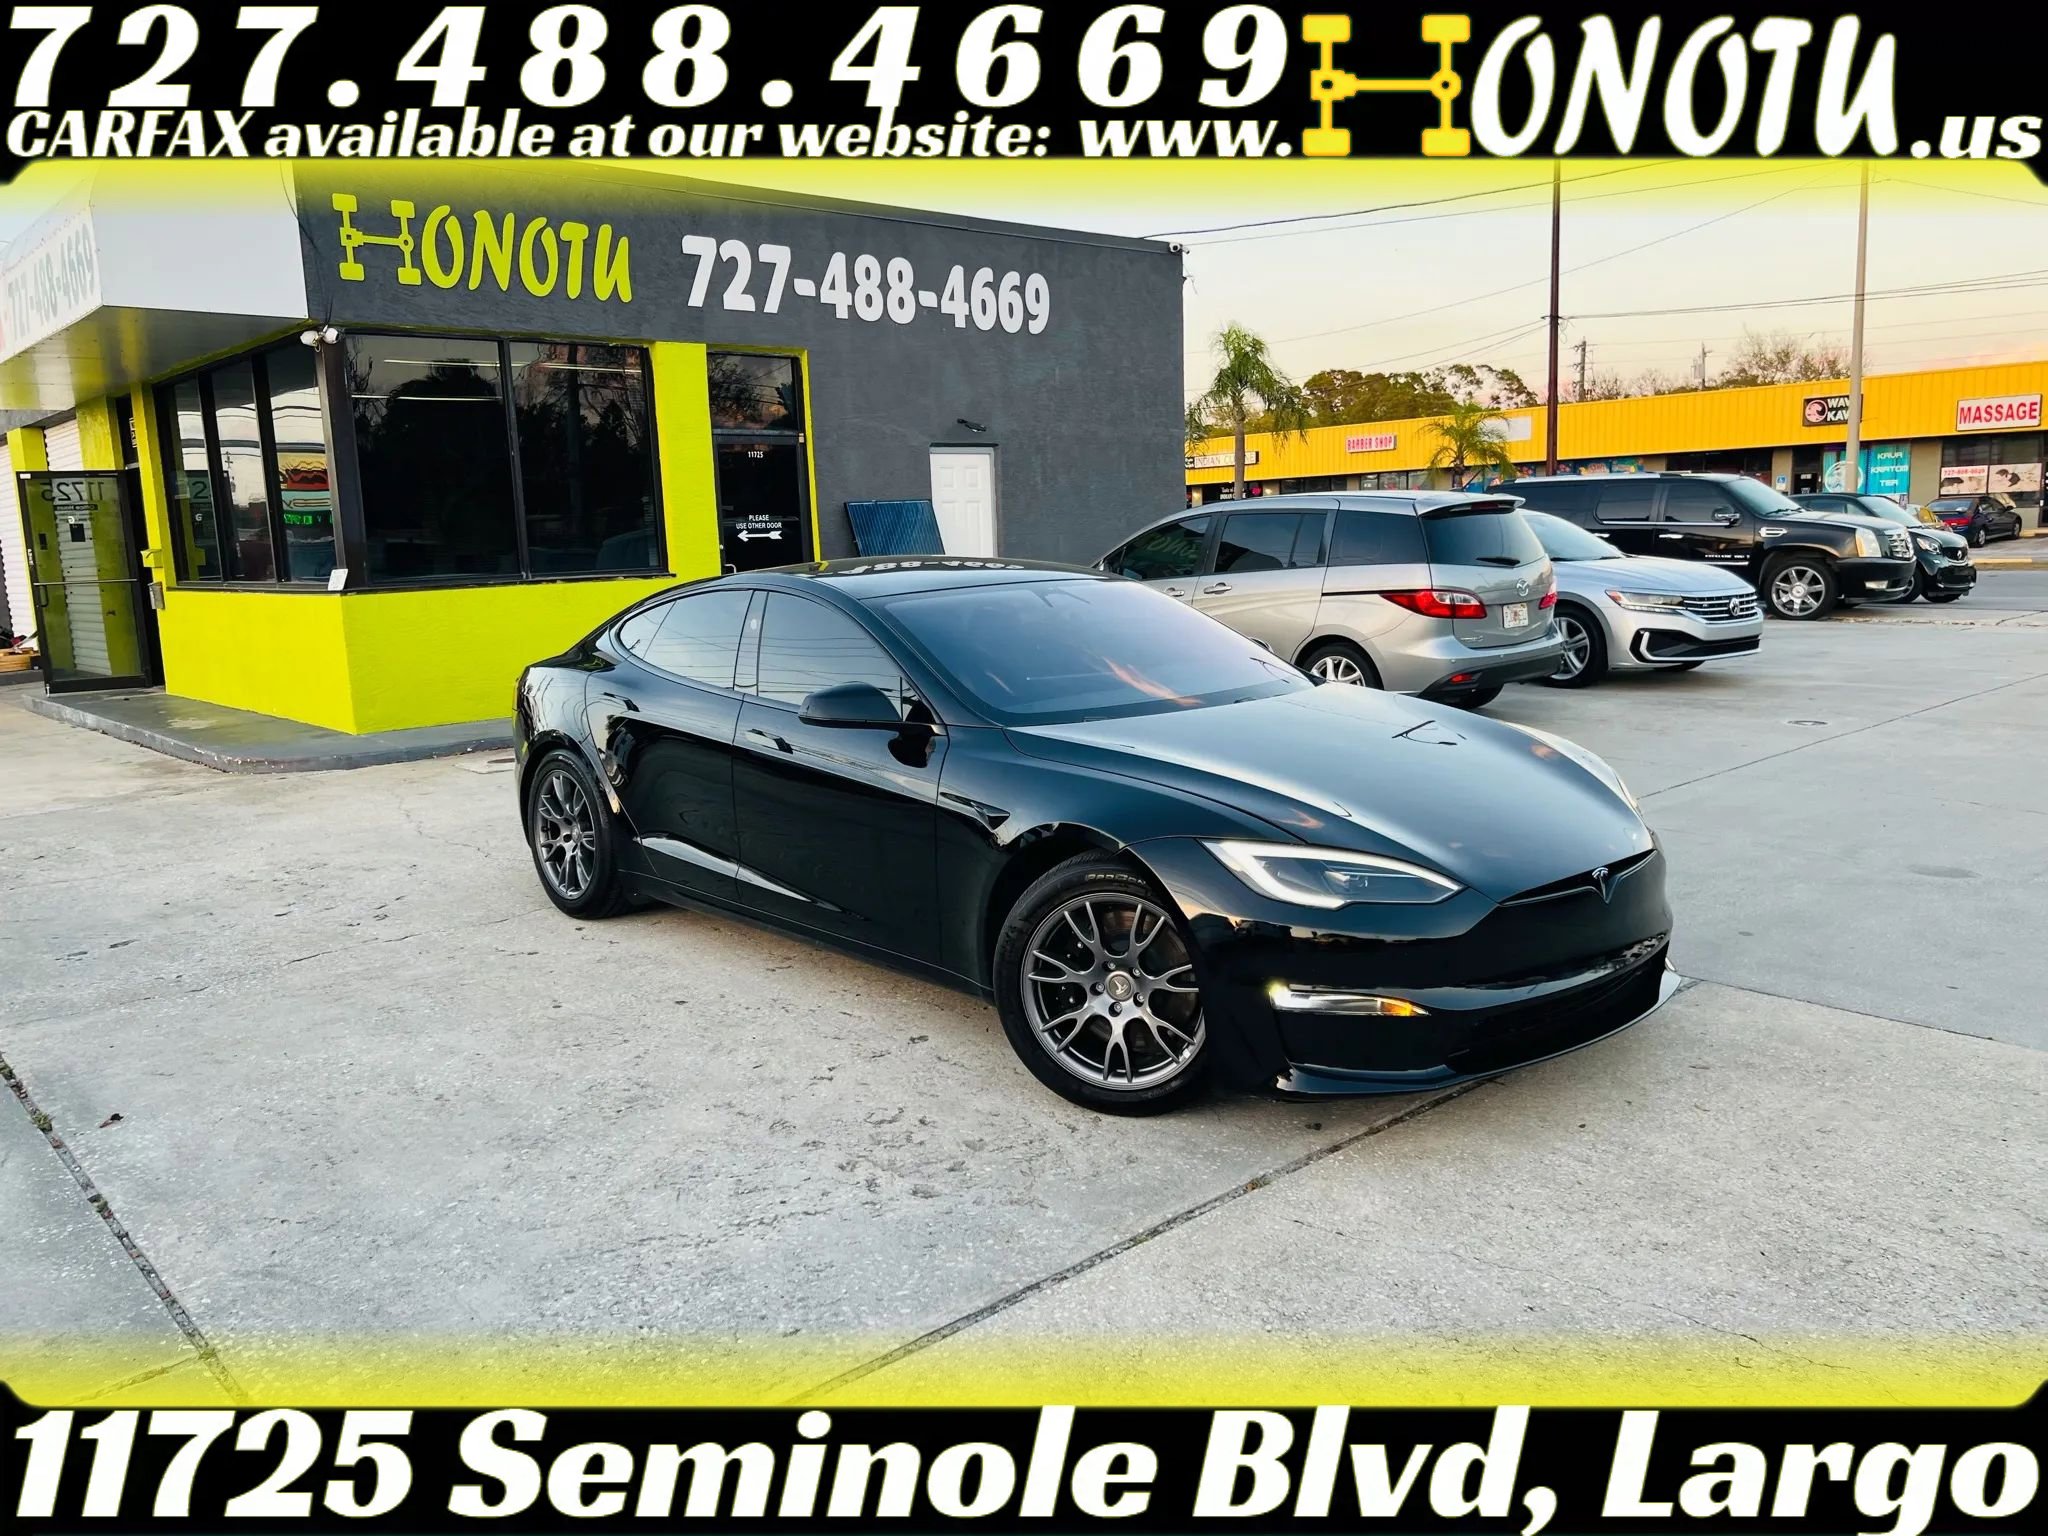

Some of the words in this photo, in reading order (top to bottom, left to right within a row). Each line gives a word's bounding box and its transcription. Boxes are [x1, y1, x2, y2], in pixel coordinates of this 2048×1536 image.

[681, 234, 1050, 335] 727-488-4669
[1827, 397, 1850, 409] WAV
[1827, 409, 1849, 422] KAV
[1958, 401, 2038, 425] MASSAGE
[1347, 437, 1373, 451] BARBER
[1374, 435, 1393, 449] SHOP
[1195, 456, 1220, 466] INDIAN
[1224, 453, 1255, 466] CUNE
[766, 521, 782, 529] DOOR
